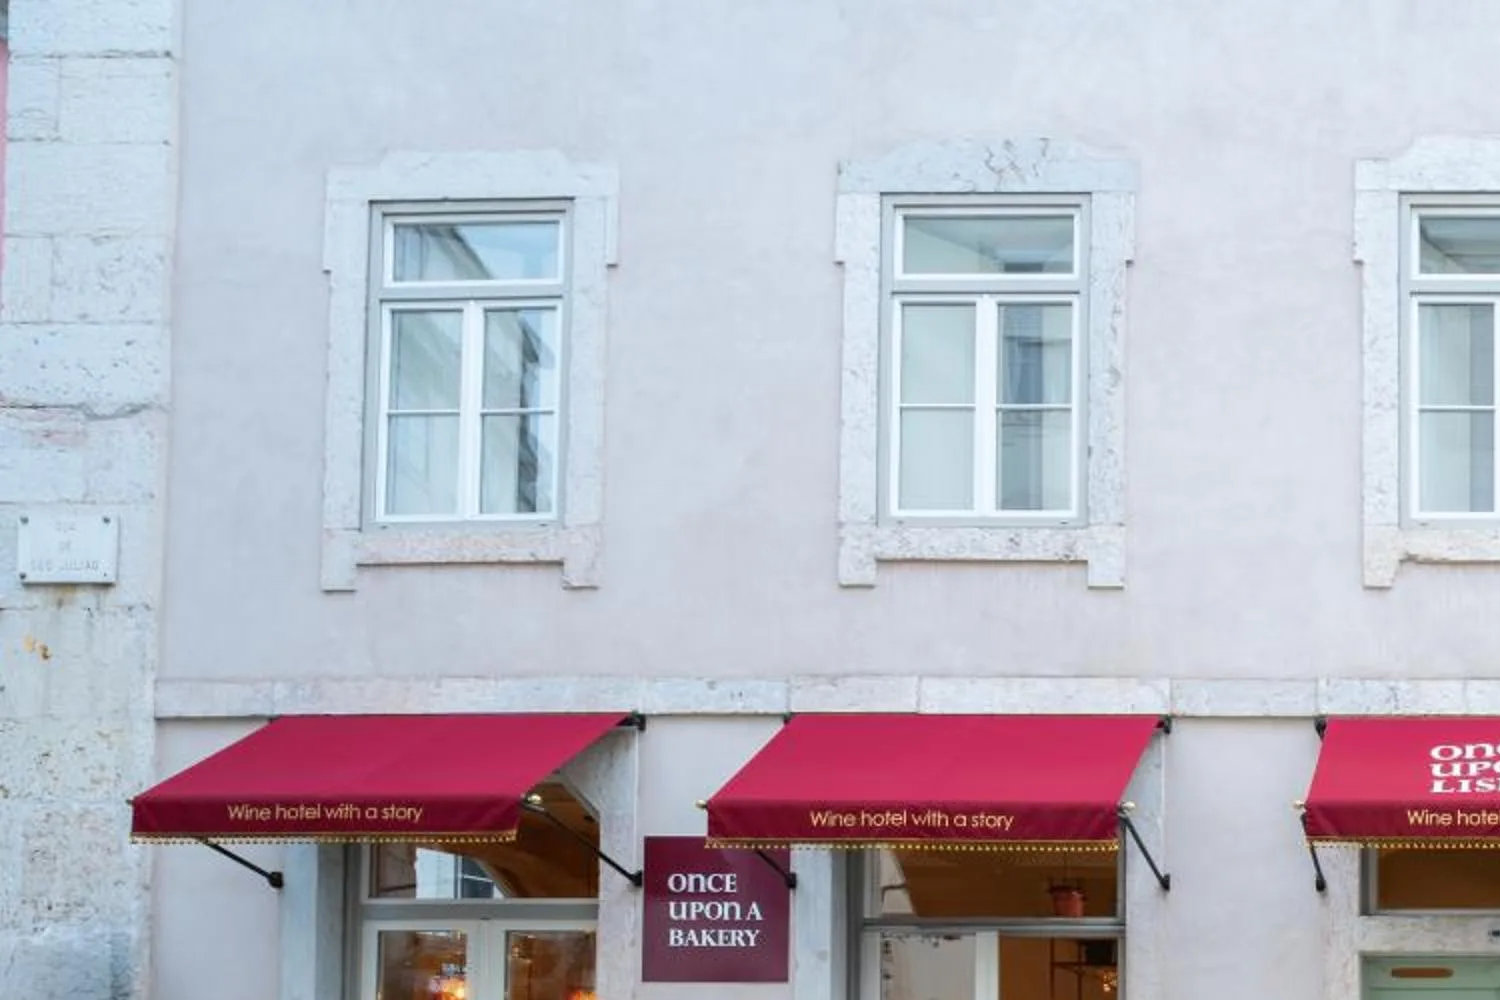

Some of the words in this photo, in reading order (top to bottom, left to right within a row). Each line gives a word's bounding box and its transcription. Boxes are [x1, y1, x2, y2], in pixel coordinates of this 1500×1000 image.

[227, 803, 271, 821] Wine
[275, 803, 321, 820] hotel
[324, 803, 361, 819] with
[365, 807, 378, 819] a
[381, 803, 423, 823] story
[809, 810, 857, 827] Wine
[860, 809, 907, 827] hotel
[911, 809, 949, 827] with
[953, 814, 967, 827] a
[971, 812, 1015, 831] story
[1407, 809, 1453, 826] Wine
[745, 901, 763, 920] A
[668, 928, 760, 947] BAKERY
